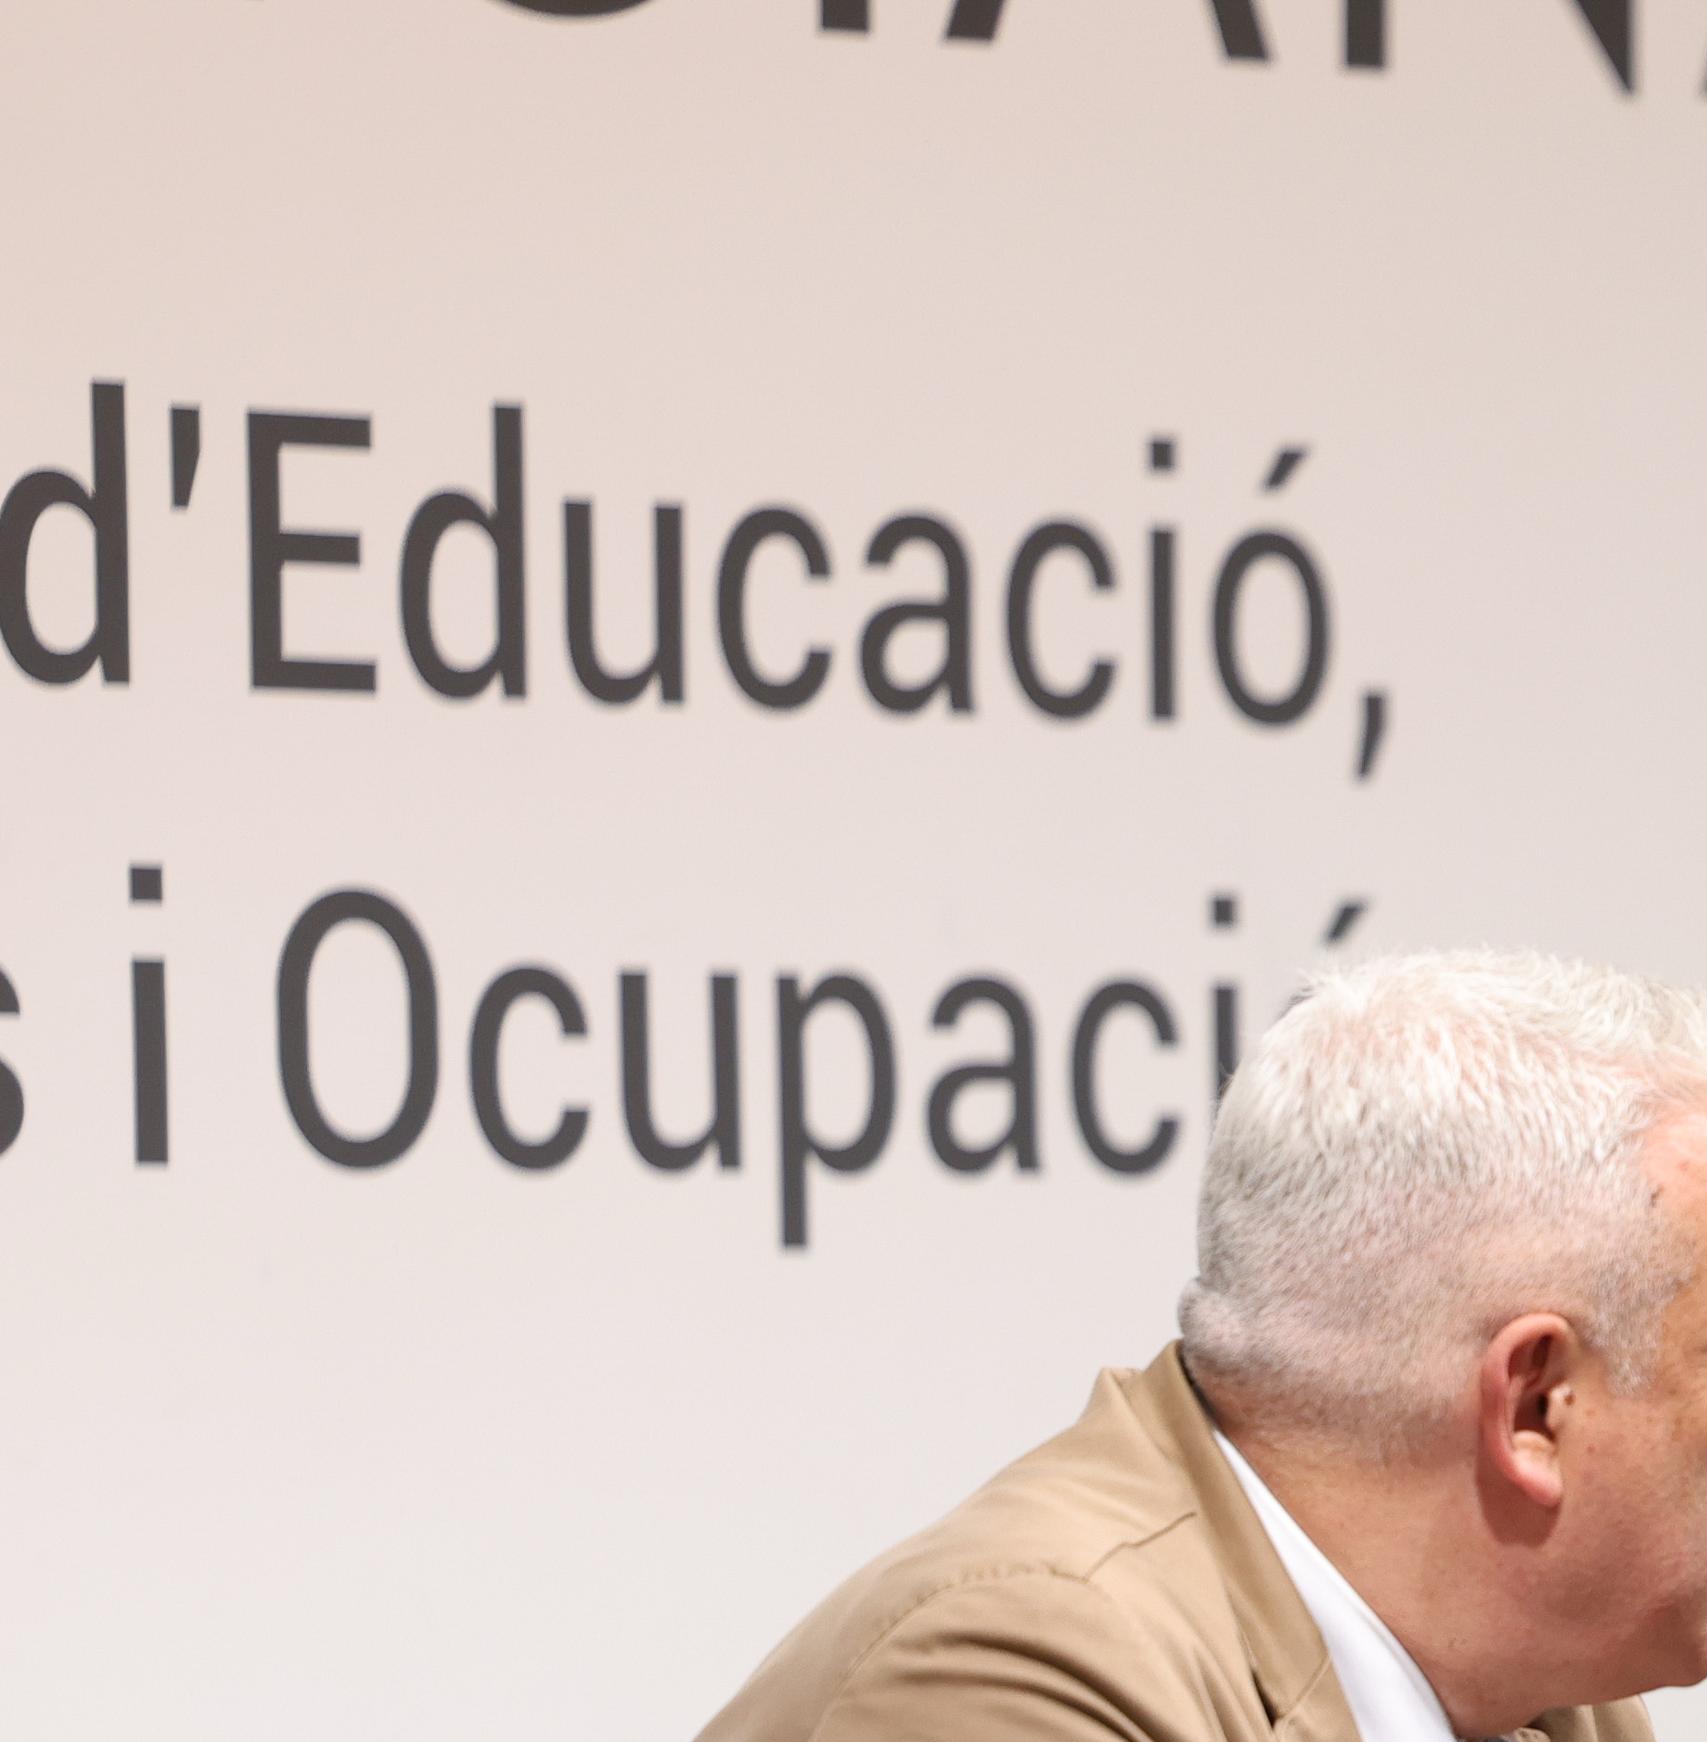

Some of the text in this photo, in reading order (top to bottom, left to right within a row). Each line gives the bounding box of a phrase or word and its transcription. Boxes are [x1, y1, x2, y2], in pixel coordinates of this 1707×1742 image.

[0, 380, 1390, 780] d'Educació,
[128, 864, 170, 1166] i
[275, 888, 1367, 1250] Ocupaci
